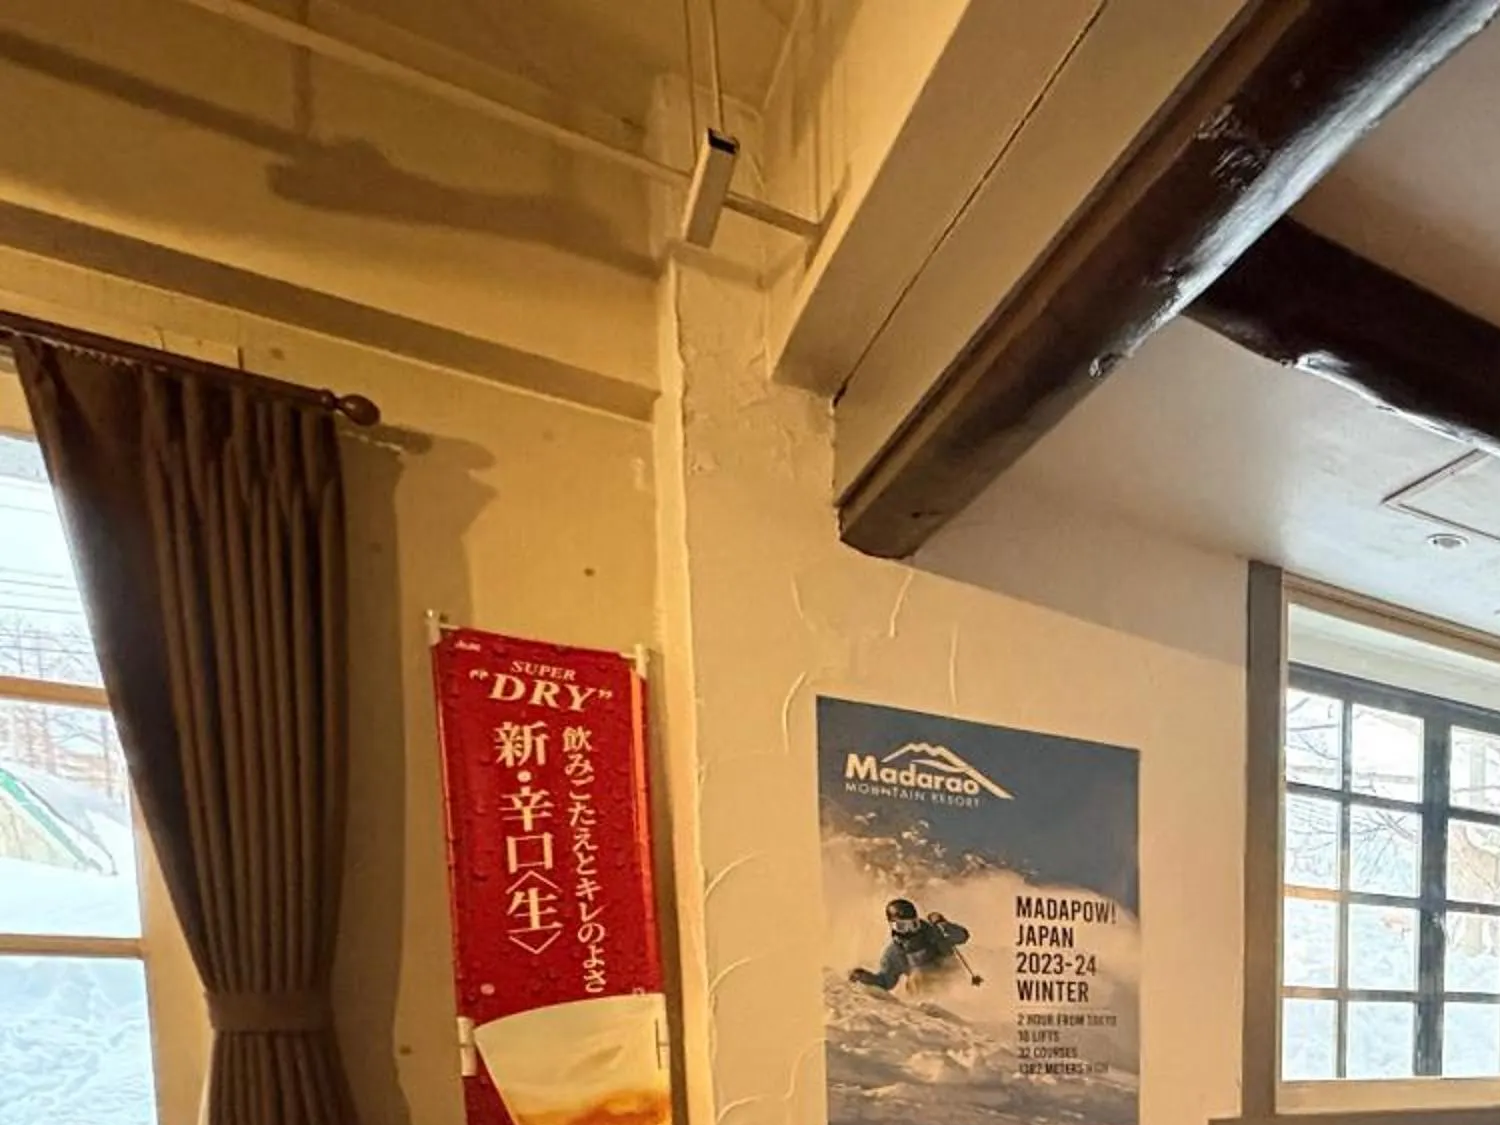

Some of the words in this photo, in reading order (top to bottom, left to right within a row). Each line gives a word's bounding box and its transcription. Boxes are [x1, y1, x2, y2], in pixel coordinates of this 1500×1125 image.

[511, 660, 576, 680] SUPER
[845, 753, 980, 796] Madarao
[845, 783, 926, 801] MOUNTAIN
[931, 793, 981, 809] RESORT
[1015, 895, 1116, 924] MADAPOW!
[1015, 924, 1073, 948] JAPAN
[1016, 952, 1097, 976] 2023-24
[1017, 980, 1089, 1003] WINTER
